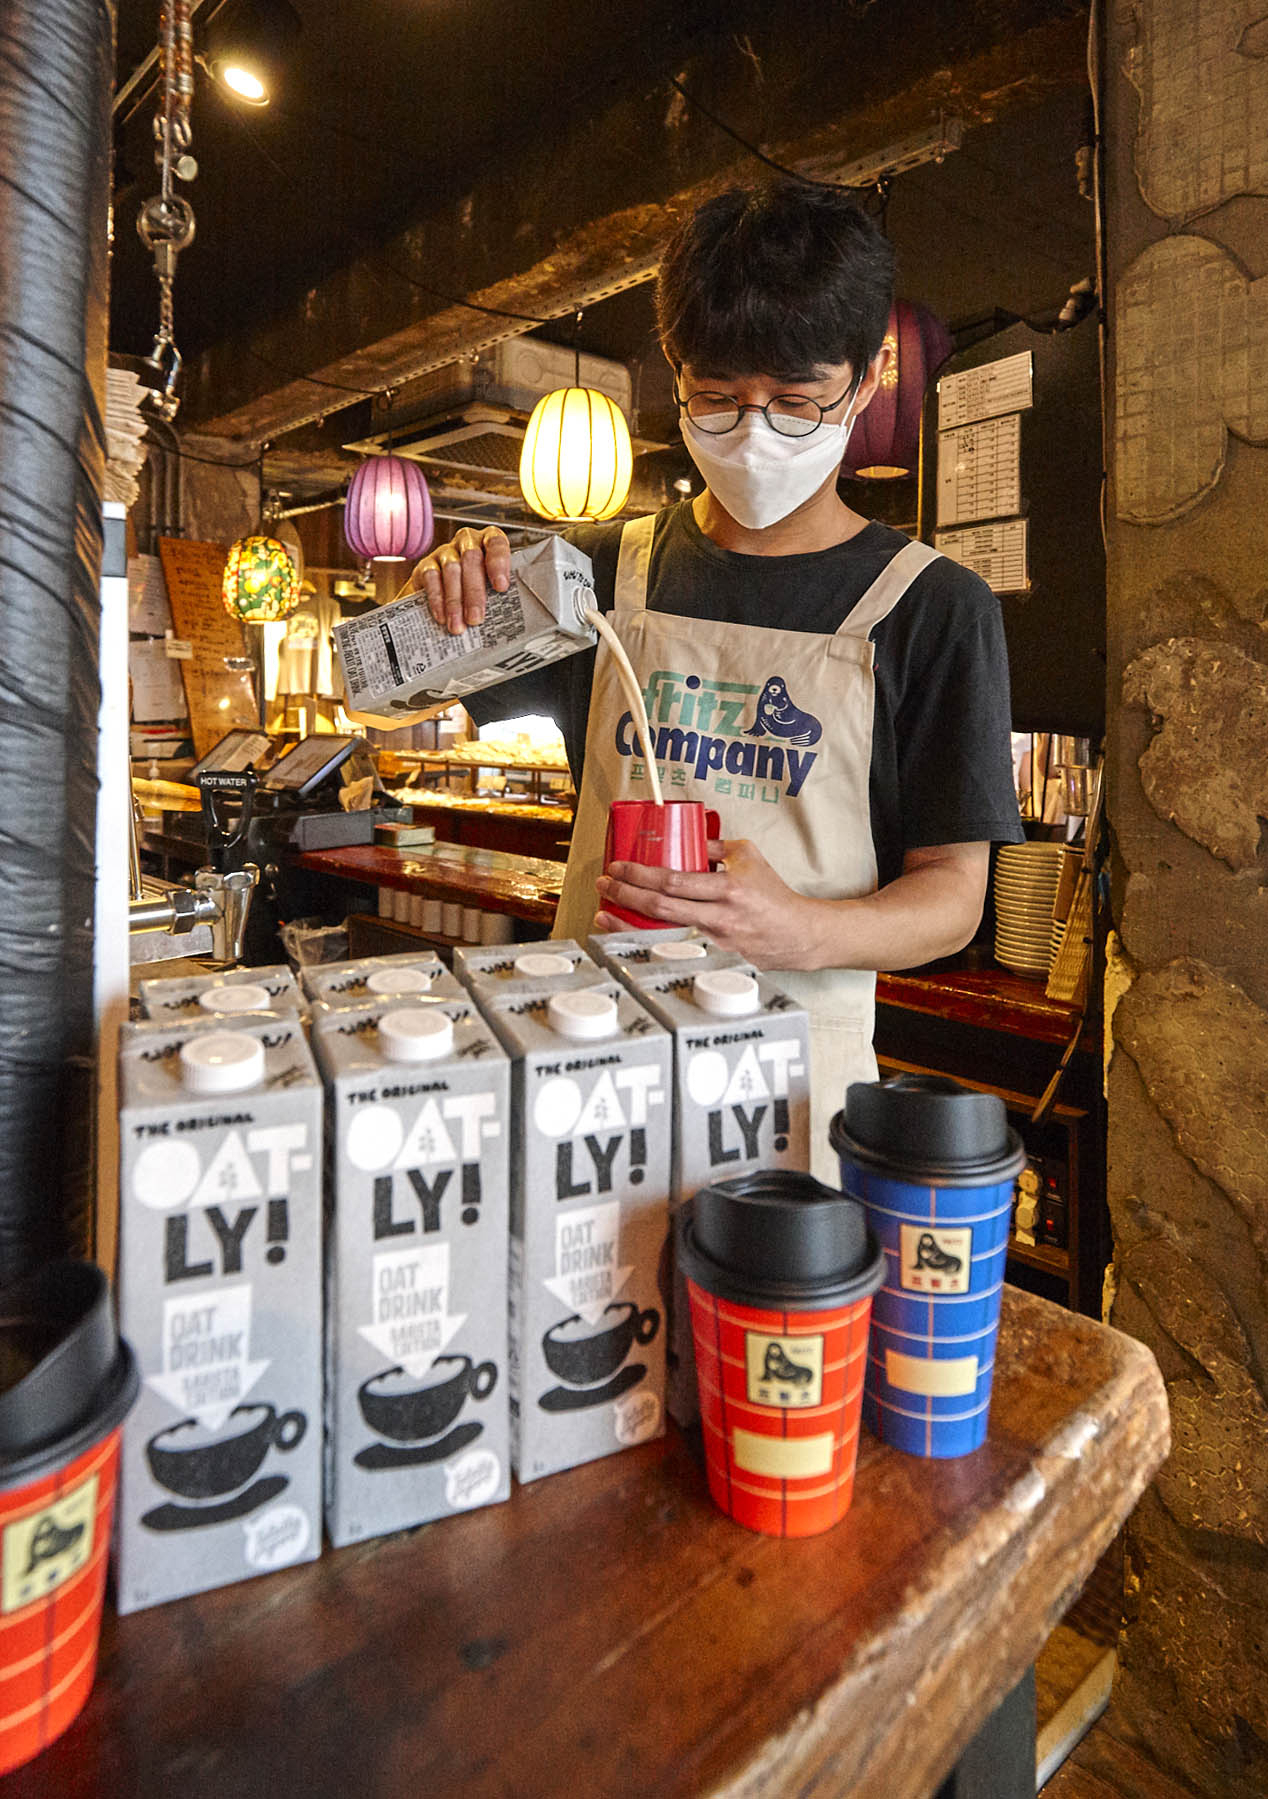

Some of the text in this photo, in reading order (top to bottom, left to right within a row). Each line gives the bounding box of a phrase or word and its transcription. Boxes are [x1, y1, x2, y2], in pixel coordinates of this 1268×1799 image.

[494, 651, 545, 673] LY!
[641, 670, 761, 737] fritz
[615, 710, 818, 798] Company
[200, 776, 247, 787] HOT WATER
[714, 777, 780, 804] 컴퍼니
[686, 1029, 764, 1050] THE ORIGINAL
[535, 1053, 622, 1077] THE ORIGINAL
[348, 1080, 450, 1106] THE ORIGINAL
[133, 1113, 254, 1139] THE ORIGINAL
[707, 1098, 789, 1167] LY!
[556, 1127, 647, 1201] LY!
[373, 1162, 482, 1241] LY!
[164, 1198, 290, 1284] LY!
[561, 1220, 595, 1250] OAT
[561, 1241, 615, 1276] DRINK
[380, 1261, 421, 1295] OAT
[380, 1286, 443, 1323] DRINK
[170, 1305, 217, 1341] OAT
[170, 1330, 244, 1372] DRINK
